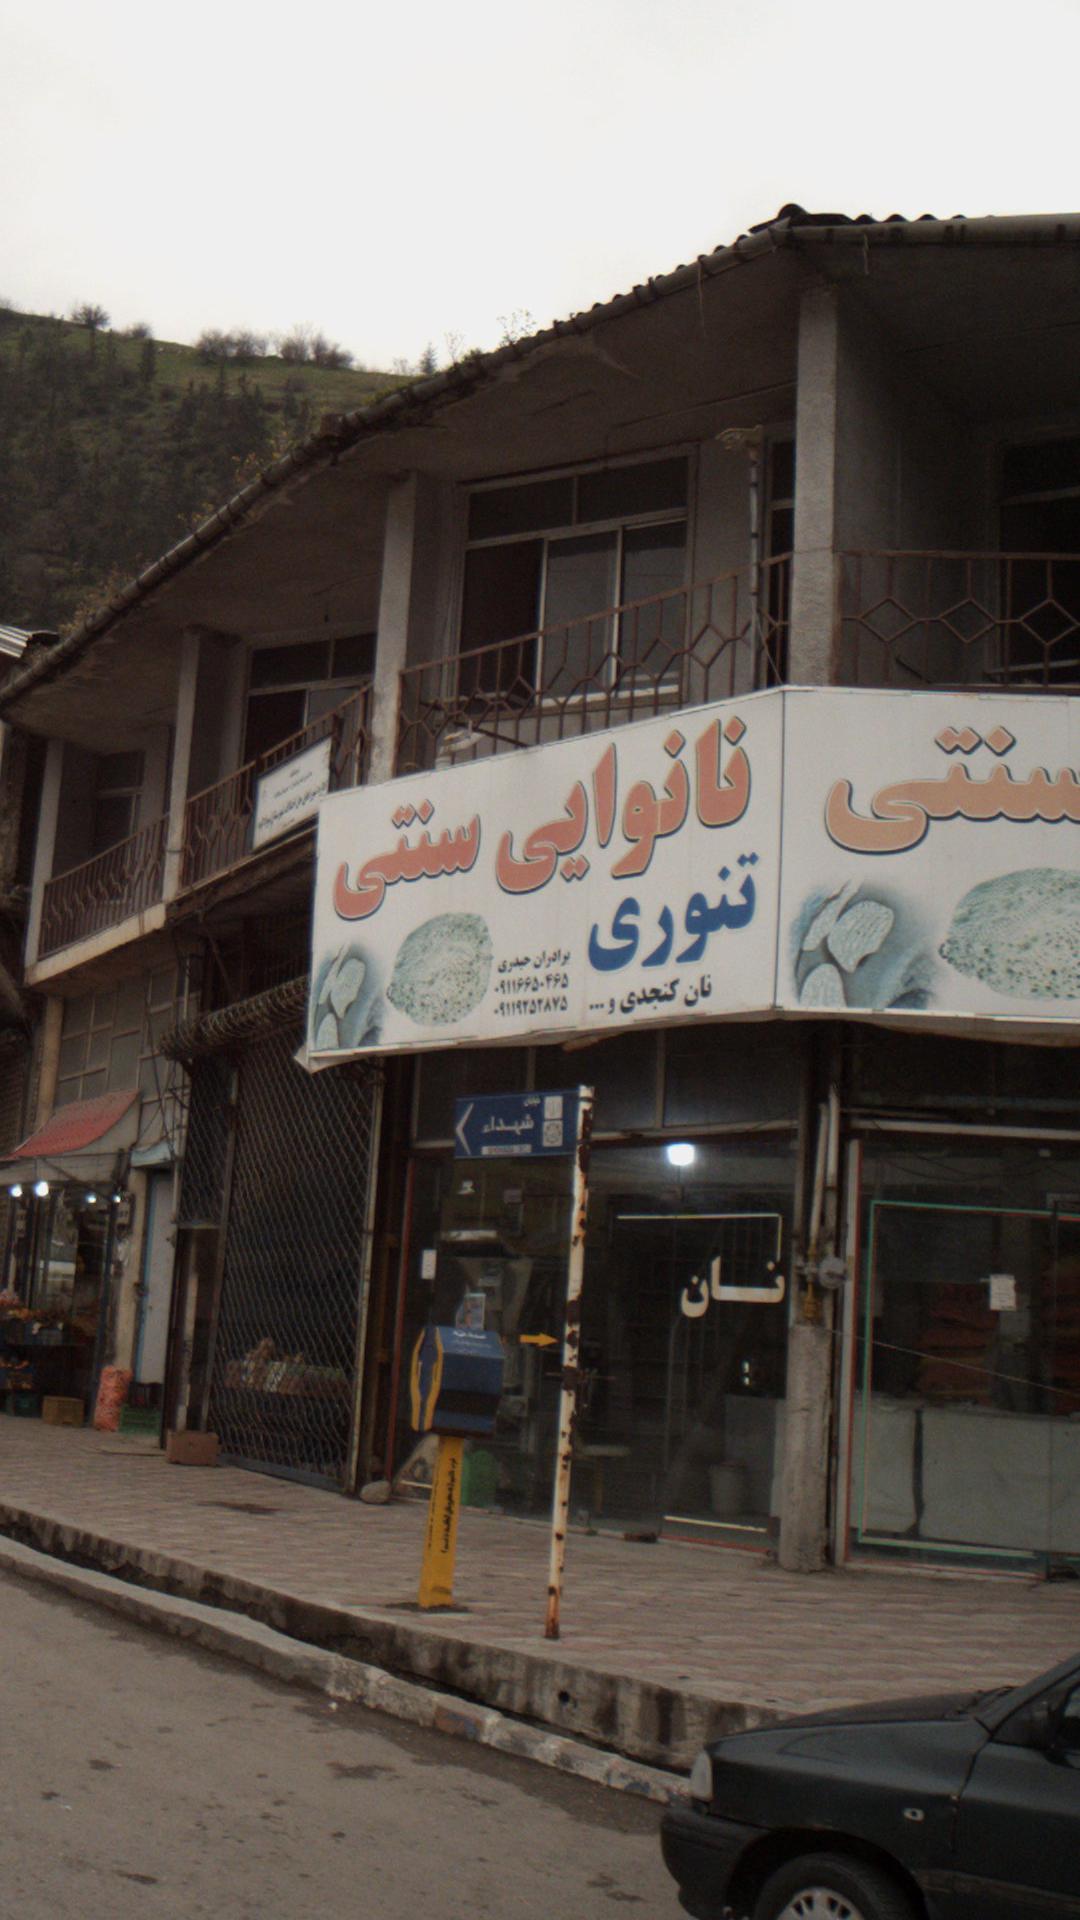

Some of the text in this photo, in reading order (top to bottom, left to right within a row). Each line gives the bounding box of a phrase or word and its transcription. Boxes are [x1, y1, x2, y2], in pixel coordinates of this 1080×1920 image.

[332, 716, 752, 921] نانوایی سنتی
[587, 851, 760, 972] تنوری
[618, 977, 682, 1014] کنجدی
[683, 974, 713, 1008] نان
[680, 1255, 786, 1319] نان
